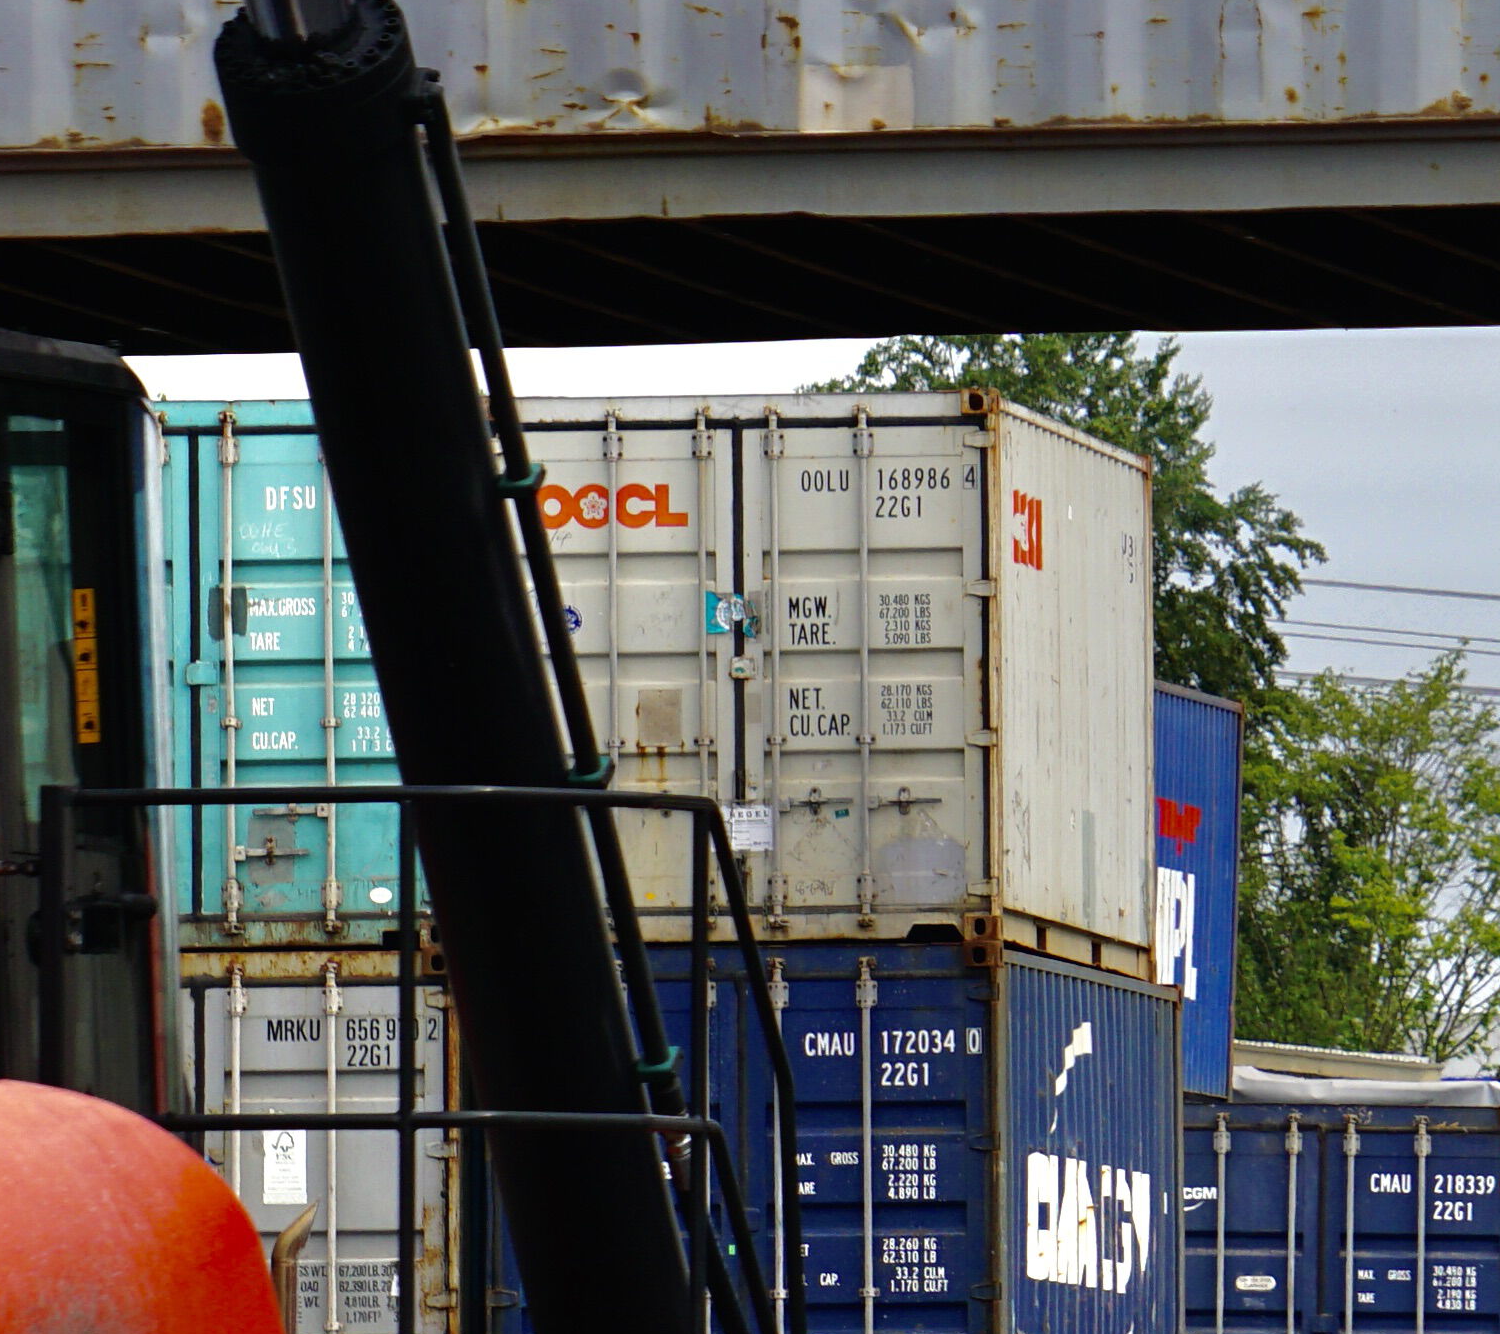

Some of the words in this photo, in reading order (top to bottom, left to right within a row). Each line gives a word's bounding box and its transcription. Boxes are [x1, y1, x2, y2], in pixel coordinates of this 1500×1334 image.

[876, 467, 951, 492] 168986
[964, 465, 976, 489] 4
[265, 485, 317, 511] DFSU
[536, 483, 689, 530] OOCL
[875, 495, 923, 519] 22G1
[788, 596, 833, 619] MGW.
[914, 594, 931, 606] KGS
[879, 607, 910, 618] 67.200
[914, 607, 931, 618] LBS
[250, 632, 281, 651] TARE
[789, 623, 837, 646] TARE.
[884, 620, 911, 631] 2.310
[915, 619, 931, 631] KGS
[884, 632, 911, 644] 5.090
[915, 632, 932, 644] LBS
[252, 697, 275, 716] NET
[789, 687, 826, 710] NET.
[881, 685, 912, 696] 28.170
[916, 684, 933, 696] KGS
[881, 698, 912, 709] 62.110
[916, 698, 933, 709] LBS
[252, 731, 299, 750] CU.CAP.
[266, 1018, 322, 1042] MRKU
[346, 1018, 380, 1041] 656
[428, 1018, 438, 1041] 2
[804, 1031, 855, 1057] CMAU
[880, 1029, 957, 1055] 172034
[969, 1028, 981, 1053] 0
[346, 1044, 391, 1068] 22G1
[880, 1061, 930, 1087] 22G1
[830, 1152, 859, 1166] GROSS
[882, 1144, 920, 1158] 30.480
[923, 1144, 937, 1158] KG
[882, 1158, 920, 1171] 67.200
[923, 1158, 937, 1171] LB
[888, 1174, 920, 1187] 2.220
[923, 1174, 937, 1187] KG
[1369, 1173, 1412, 1193] CMAU
[1433, 1174, 1496, 1194] 218339
[888, 1187, 920, 1200] 4.890
[923, 1187, 937, 1200] LB
[1183, 1186, 1218, 1200] CGM
[1432, 1200, 1474, 1221] 22G1
[882, 1238, 920, 1250] 28.260
[924, 1238, 937, 1250] KG
[882, 1251, 920, 1263] 62.310
[924, 1251, 937, 1263] LB
[820, 1273, 841, 1286] CAP.
[895, 1267, 920, 1279] 33.2
[1387, 1269, 1412, 1281] GROSS
[890, 1280, 920, 1293] 1.170
[1357, 1292, 1376, 1304] TARE
